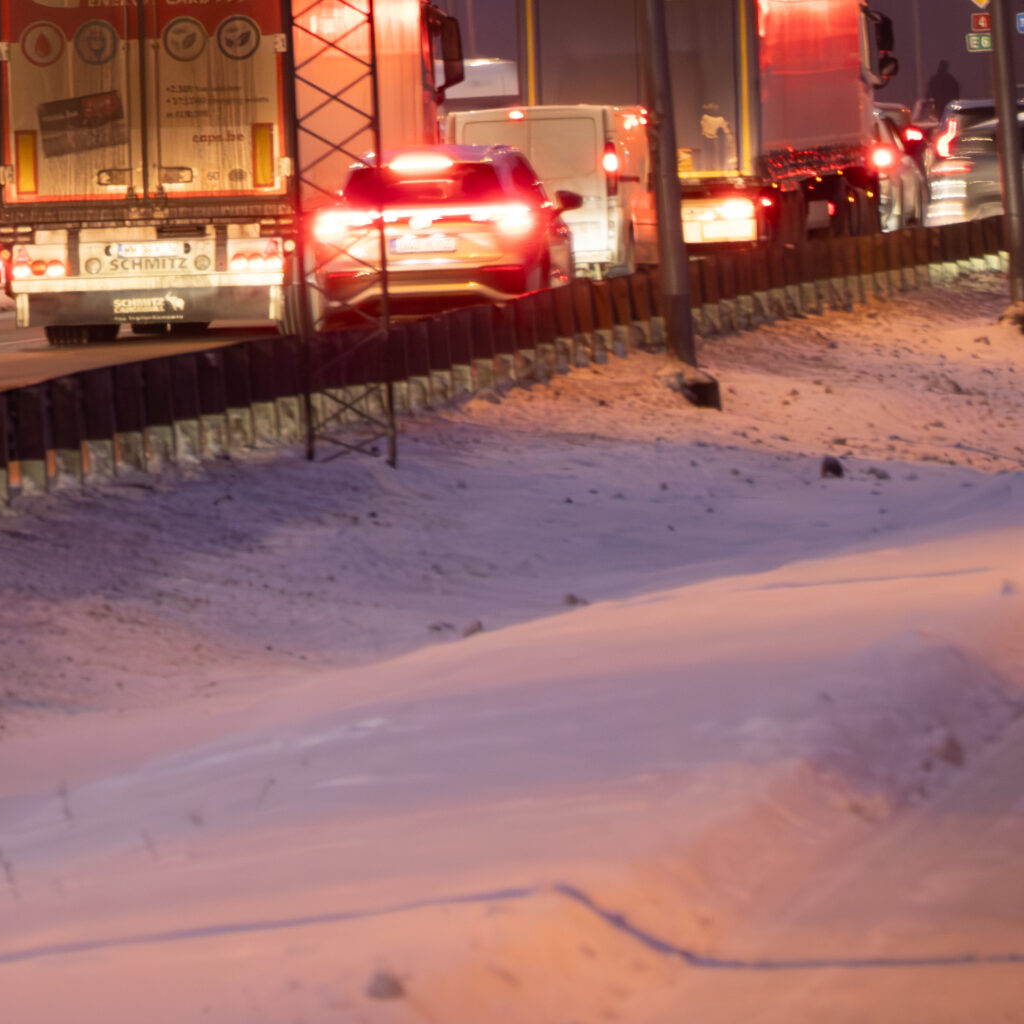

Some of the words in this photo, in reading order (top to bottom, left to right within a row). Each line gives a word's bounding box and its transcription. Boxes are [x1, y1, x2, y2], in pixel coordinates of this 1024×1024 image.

[978, 16, 988, 28] 4
[969, 36, 992, 49] E6
[110, 258, 188, 271] SCHMITZ
